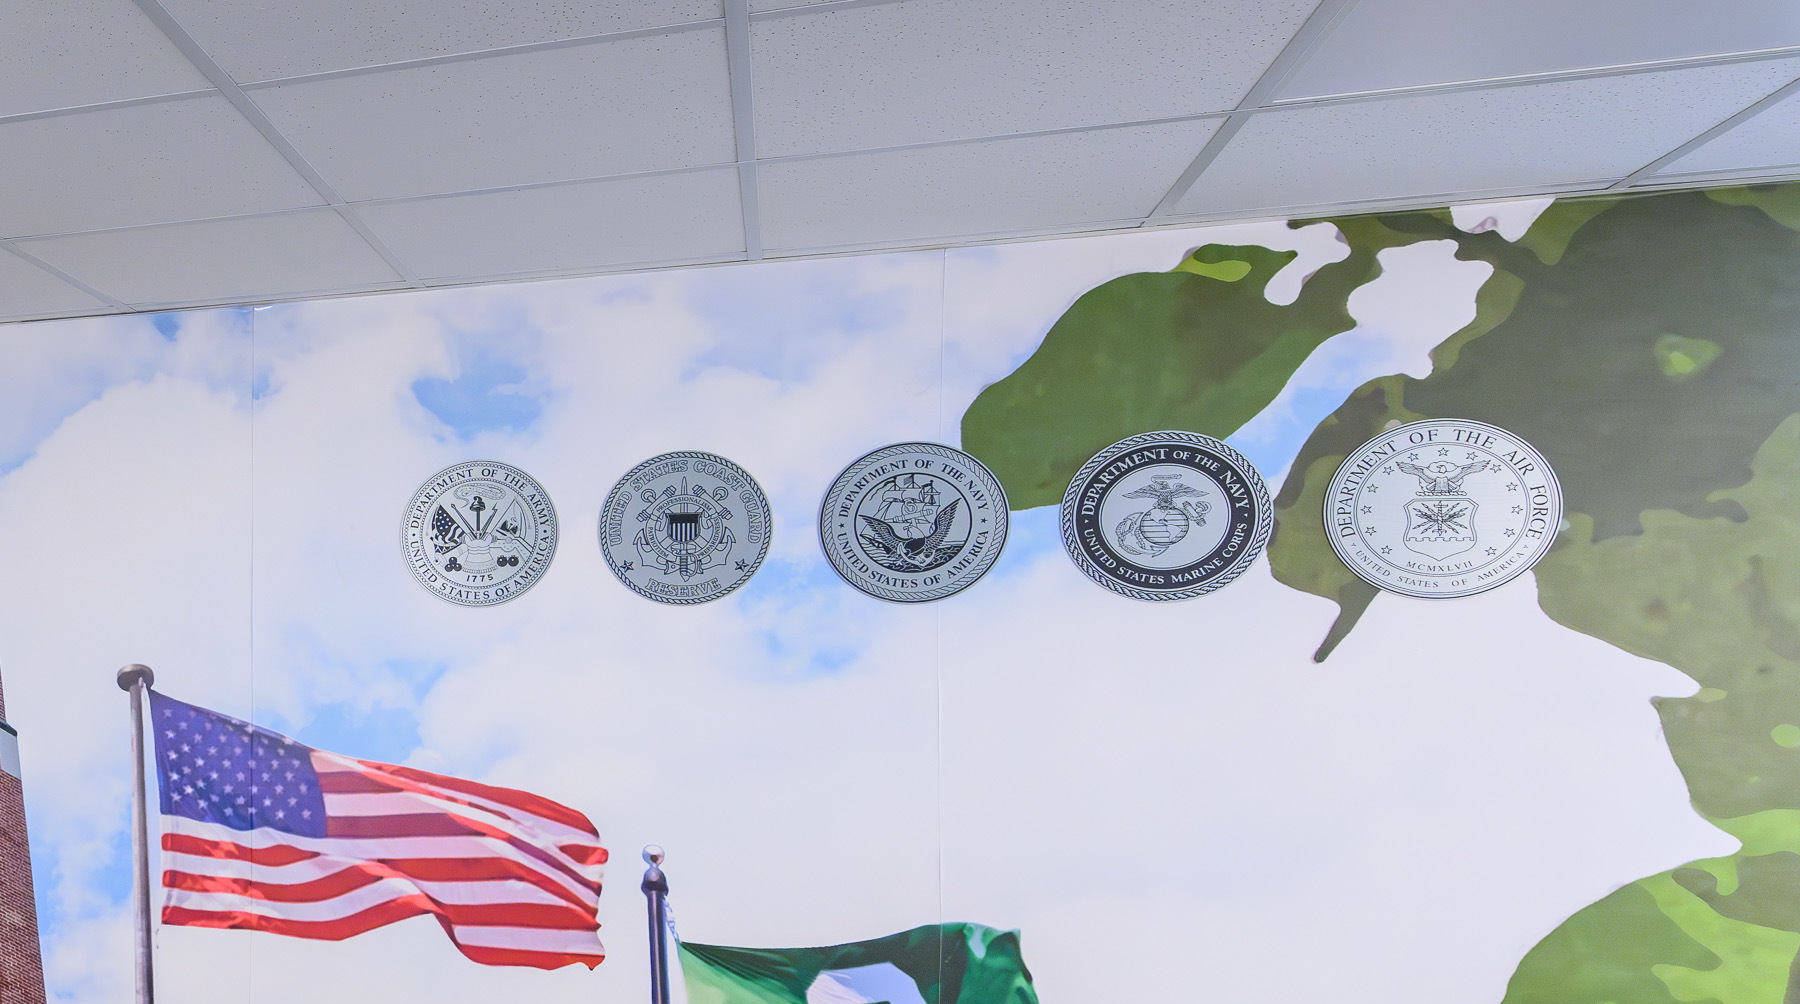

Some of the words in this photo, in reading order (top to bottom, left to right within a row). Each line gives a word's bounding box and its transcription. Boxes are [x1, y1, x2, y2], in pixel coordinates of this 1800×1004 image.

[410, 468, 474, 529] DEPARTMENT
[481, 468, 499, 478] OF
[504, 472, 529, 492] THE
[527, 491, 551, 527] ARMY
[609, 490, 633, 547] UNITED
[630, 460, 689, 492] STATES
[693, 460, 746, 491] COAST
[739, 489, 763, 544] GUARD
[656, 496, 713, 514] PROFESSIONALISM
[838, 459, 909, 518] DEPARTMENT
[914, 458, 934, 469] OF
[941, 462, 966, 484] THE
[964, 479, 989, 511] NAVY
[1081, 448, 1169, 516] DEPARTMENT
[1172, 449, 1192, 460] OF
[1194, 453, 1221, 472] THE
[1219, 469, 1250, 510] NAVY
[1337, 439, 1397, 538] DEPARTMENT
[1409, 428, 1439, 444] OF
[1453, 428, 1497, 450] THE
[1502, 449, 1535, 477] AIR
[1525, 484, 1549, 541] FORCE
[410, 540, 438, 583] UNITED
[439, 582, 490, 600] STATES
[495, 583, 512, 597] OF
[513, 535, 550, 589] AMERICA
[648, 526, 669, 559] PATRIOTISM
[837, 531, 869, 573] UNITED
[868, 570, 918, 589] STATES
[923, 573, 942, 587] OF
[947, 530, 989, 579] AMERICA
[1083, 528, 1117, 570] UNITED
[1117, 566, 1165, 585] STATES
[1171, 557, 1224, 584] MARINE
[1222, 522, 1248, 559] CORPS
[1355, 550, 1391, 577] UNITED
[1396, 575, 1439, 588] STATES
[1451, 578, 1468, 587] OF
[1477, 551, 1525, 582] AMERICA
[1406, 560, 1473, 572] MCMXLVII
[466, 573, 494, 583] 1775
[645, 577, 722, 597] RESERVE
